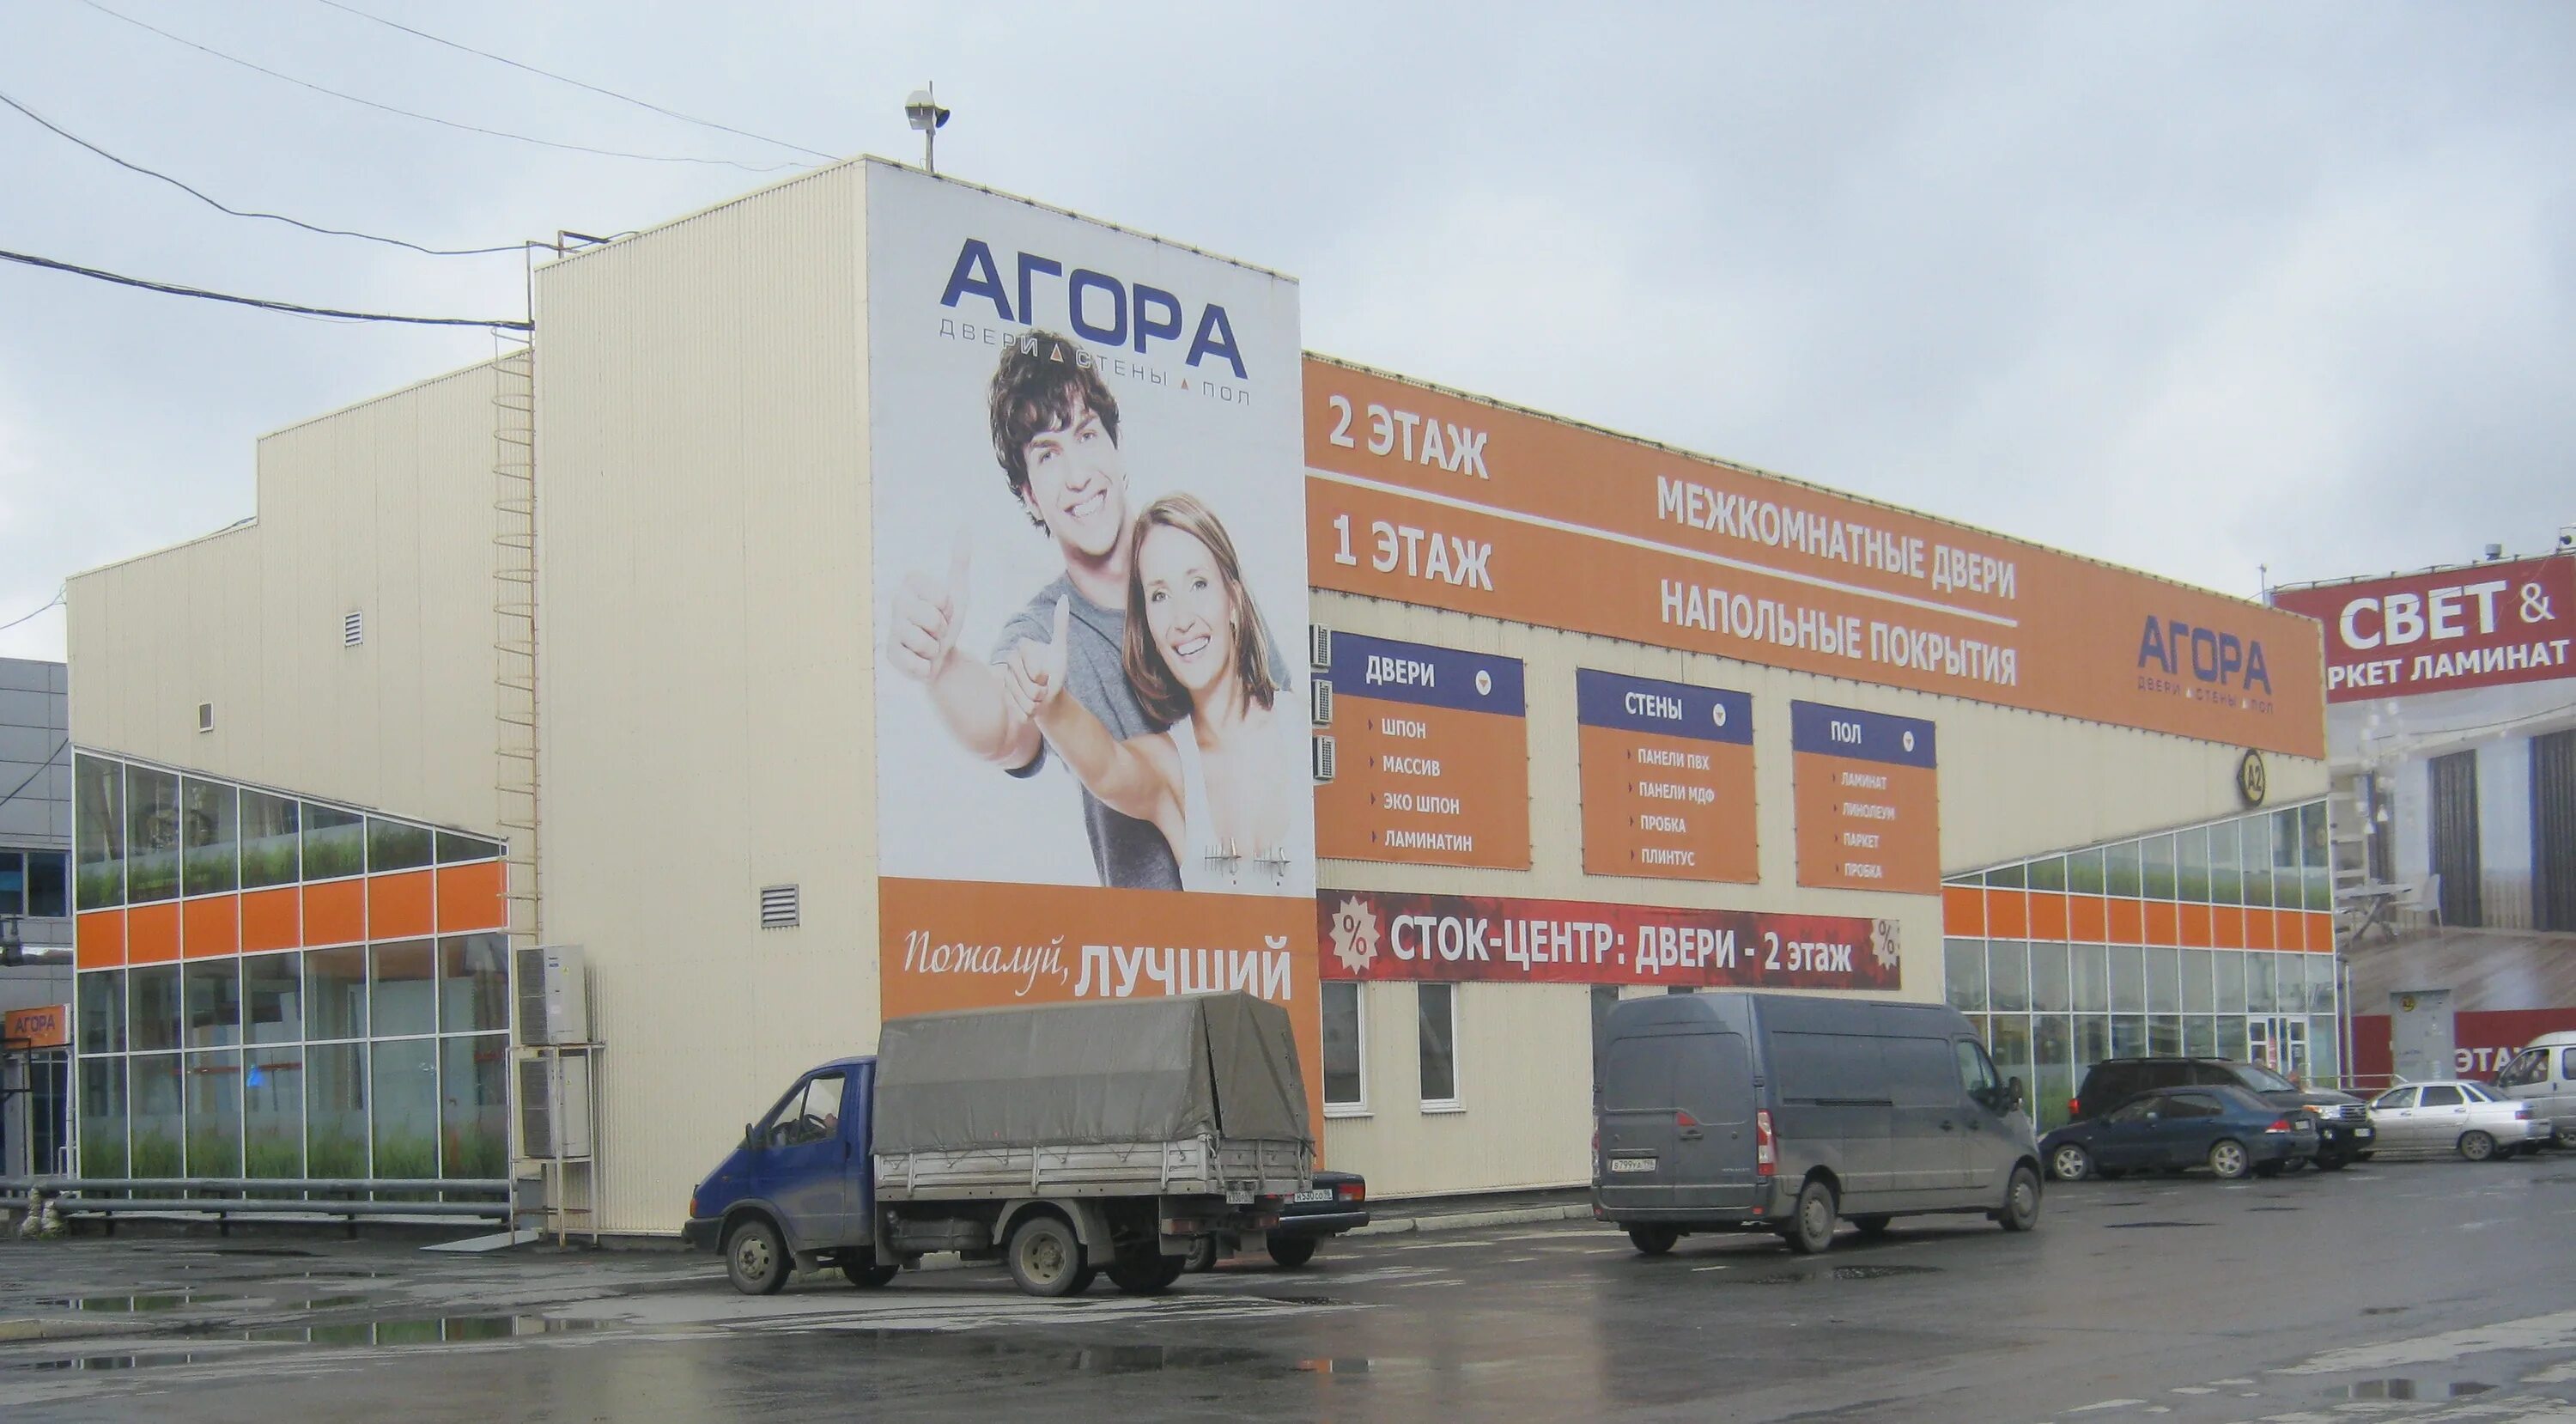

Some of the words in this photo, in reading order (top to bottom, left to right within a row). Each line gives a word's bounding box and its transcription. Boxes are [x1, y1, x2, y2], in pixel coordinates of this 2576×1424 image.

[939, 238, 1249, 380] АГОРА
[939, 319, 1038, 357] ДВЕРИ
[1076, 352, 1168, 386] СТЕНЫ
[1203, 380, 1249, 406] ПОЛ
[1328, 394, 1355, 448] 2
[1367, 404, 1490, 480] ЭТАЖ
[1656, 475, 1925, 580] МЕЖКОМНАТНЫЕ
[1932, 544, 2017, 600] ДВЕРИ
[1333, 514, 1358, 567] 1
[1372, 520, 1494, 592] ЭТАЖ
[2339, 580, 2508, 650] СВЕТ
[2519, 582, 2555, 624] &
[1661, 578, 1862, 660] НАПОЛЬНЫЕ
[1870, 621, 2017, 687] ПОКРЫТИЯ
[2138, 615, 2272, 696] АГОРА
[2410, 639, 2571, 681] ЛАМИНАТ
[1366, 654, 1436, 687] ДВЕРИ
[1625, 691, 1683, 721] СТЕНЫ
[2137, 675, 2181, 696] ДВЕРИ
[2196, 687, 2237, 707] СТЕНЫ
[2251, 698, 2274, 715] ПОЛ
[1382, 718, 1426, 739] ШПОН
[1831, 721, 1862, 745] ПОЛ
[1382, 755, 1441, 777] МАССИВ
[1637, 747, 1685, 769] ПАНЕЛИ
[1687, 754, 1710, 771] ПВХ
[1639, 782, 1686, 801] ПАНЕЛИ
[1689, 786, 1716, 805] МДФ
[1841, 771, 1887, 791] ЛАМИНАТ
[1384, 792, 1413, 812] ЭКО
[1417, 794, 1460, 815] ШПОН
[1842, 802, 1896, 821] ЛИНОЛЕУМ
[1640, 814, 1686, 834] ПРОБКА
[1385, 830, 1473, 852] ЛАМИНАТИН
[1844, 832, 1880, 849] ПАРКЕТ
[1641, 848, 1695, 867] ПЛИНТУС
[1844, 862, 1882, 879] ПРОБКА
[1390, 915, 1625, 971] СТОК-ЦЕНТР:
[1635, 926, 1735, 975] ДВЕРИ
[1744, 947, 1756, 957] -
[1764, 931, 1782, 971] 2
[1787, 941, 1854, 972] этаж
[903, 929, 1070, 997] Пожалуй,
[1074, 935, 1291, 1001] ЛУЧШИЙ
[14, 1014, 56, 1033] АГОРА
